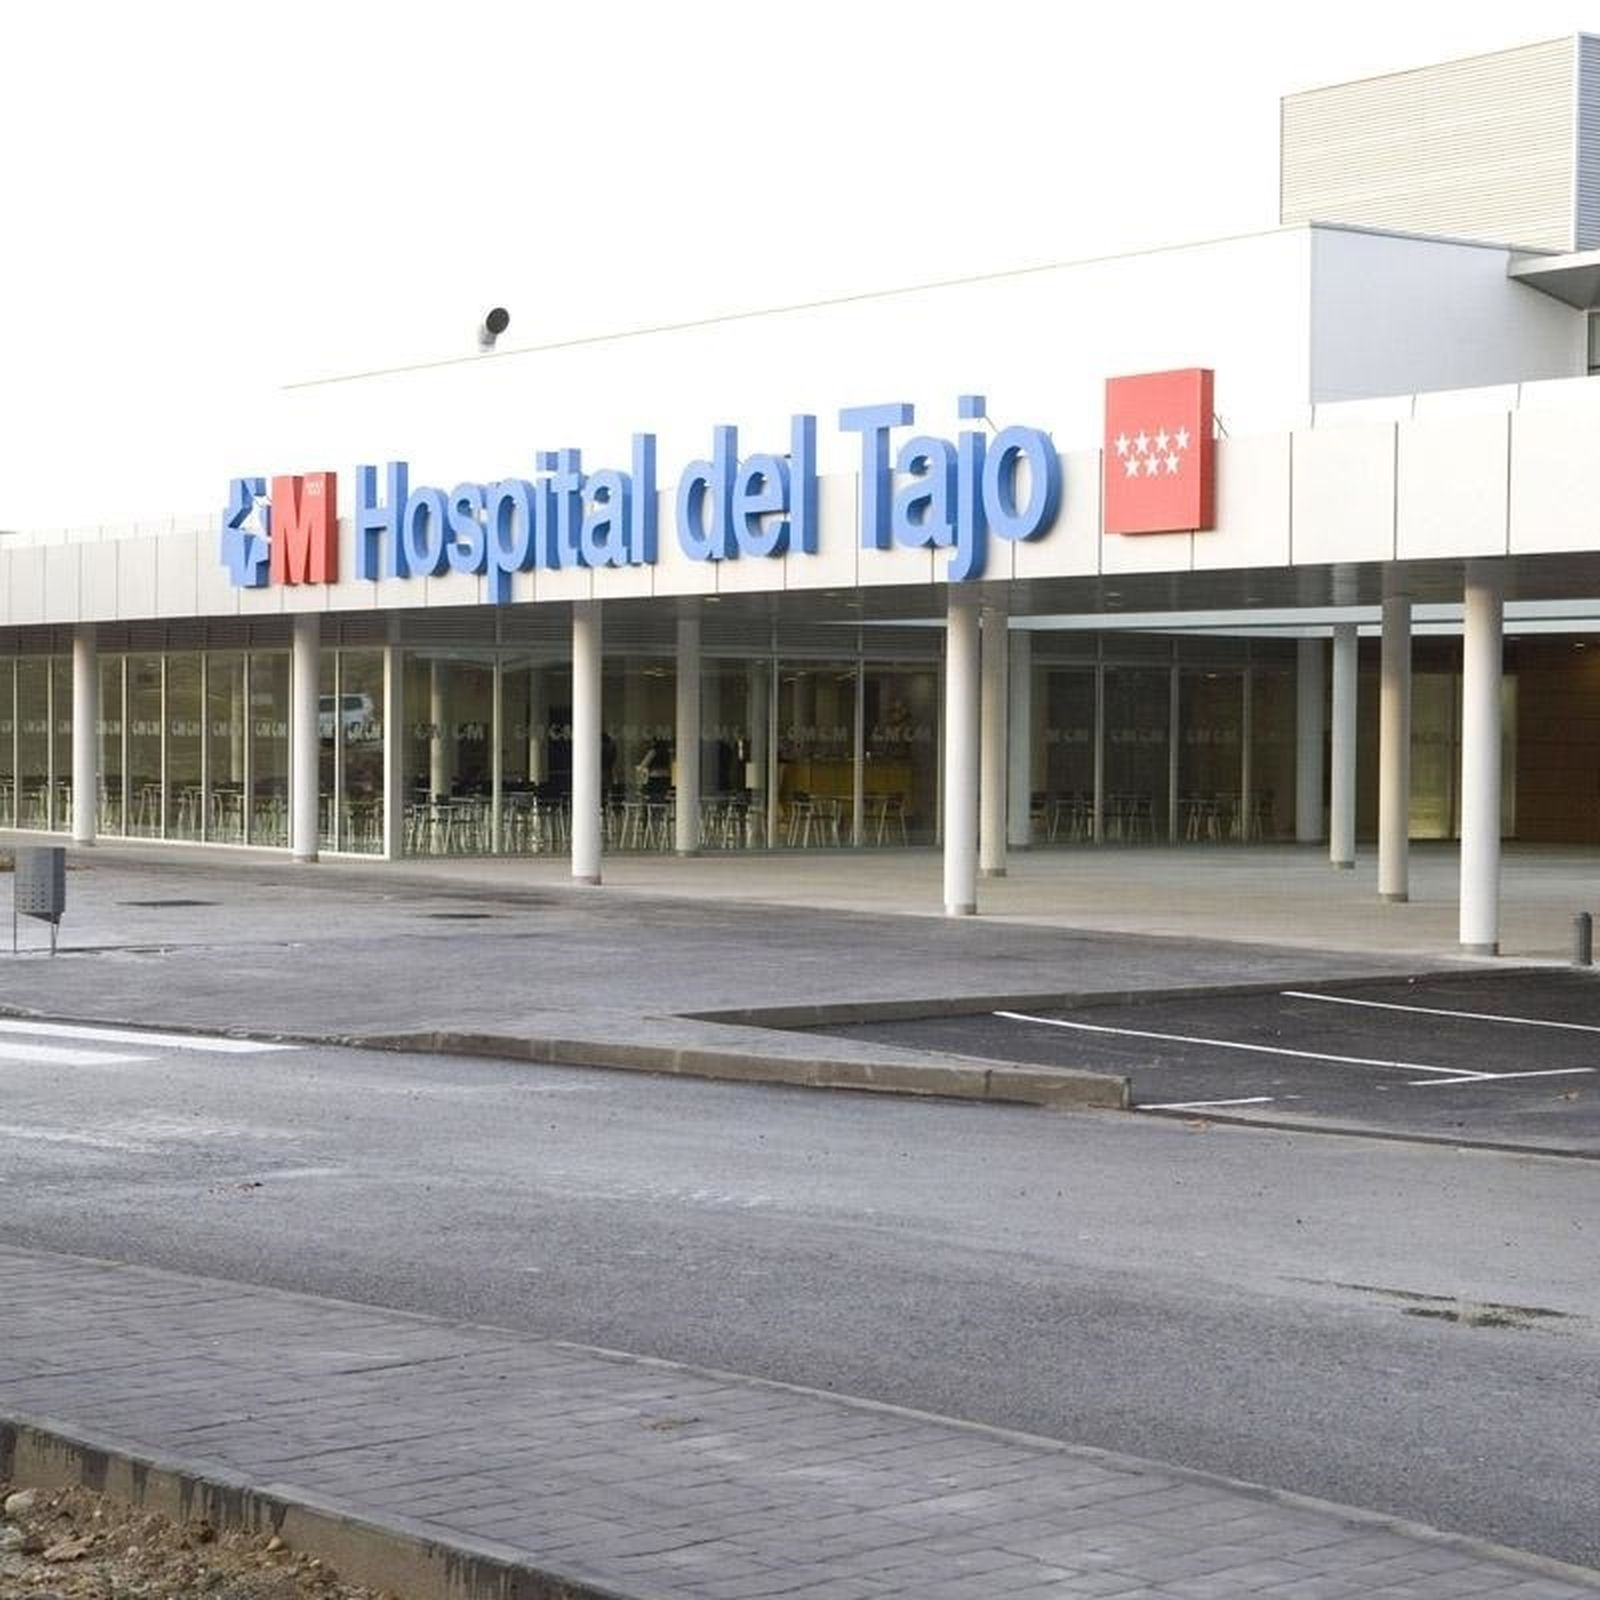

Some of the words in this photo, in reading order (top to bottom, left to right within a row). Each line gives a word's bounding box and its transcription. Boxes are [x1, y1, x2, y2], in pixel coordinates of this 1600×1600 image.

[356, 433, 658, 607] Hospital
[676, 414, 817, 562] del
[839, 395, 1063, 583] Tajo
